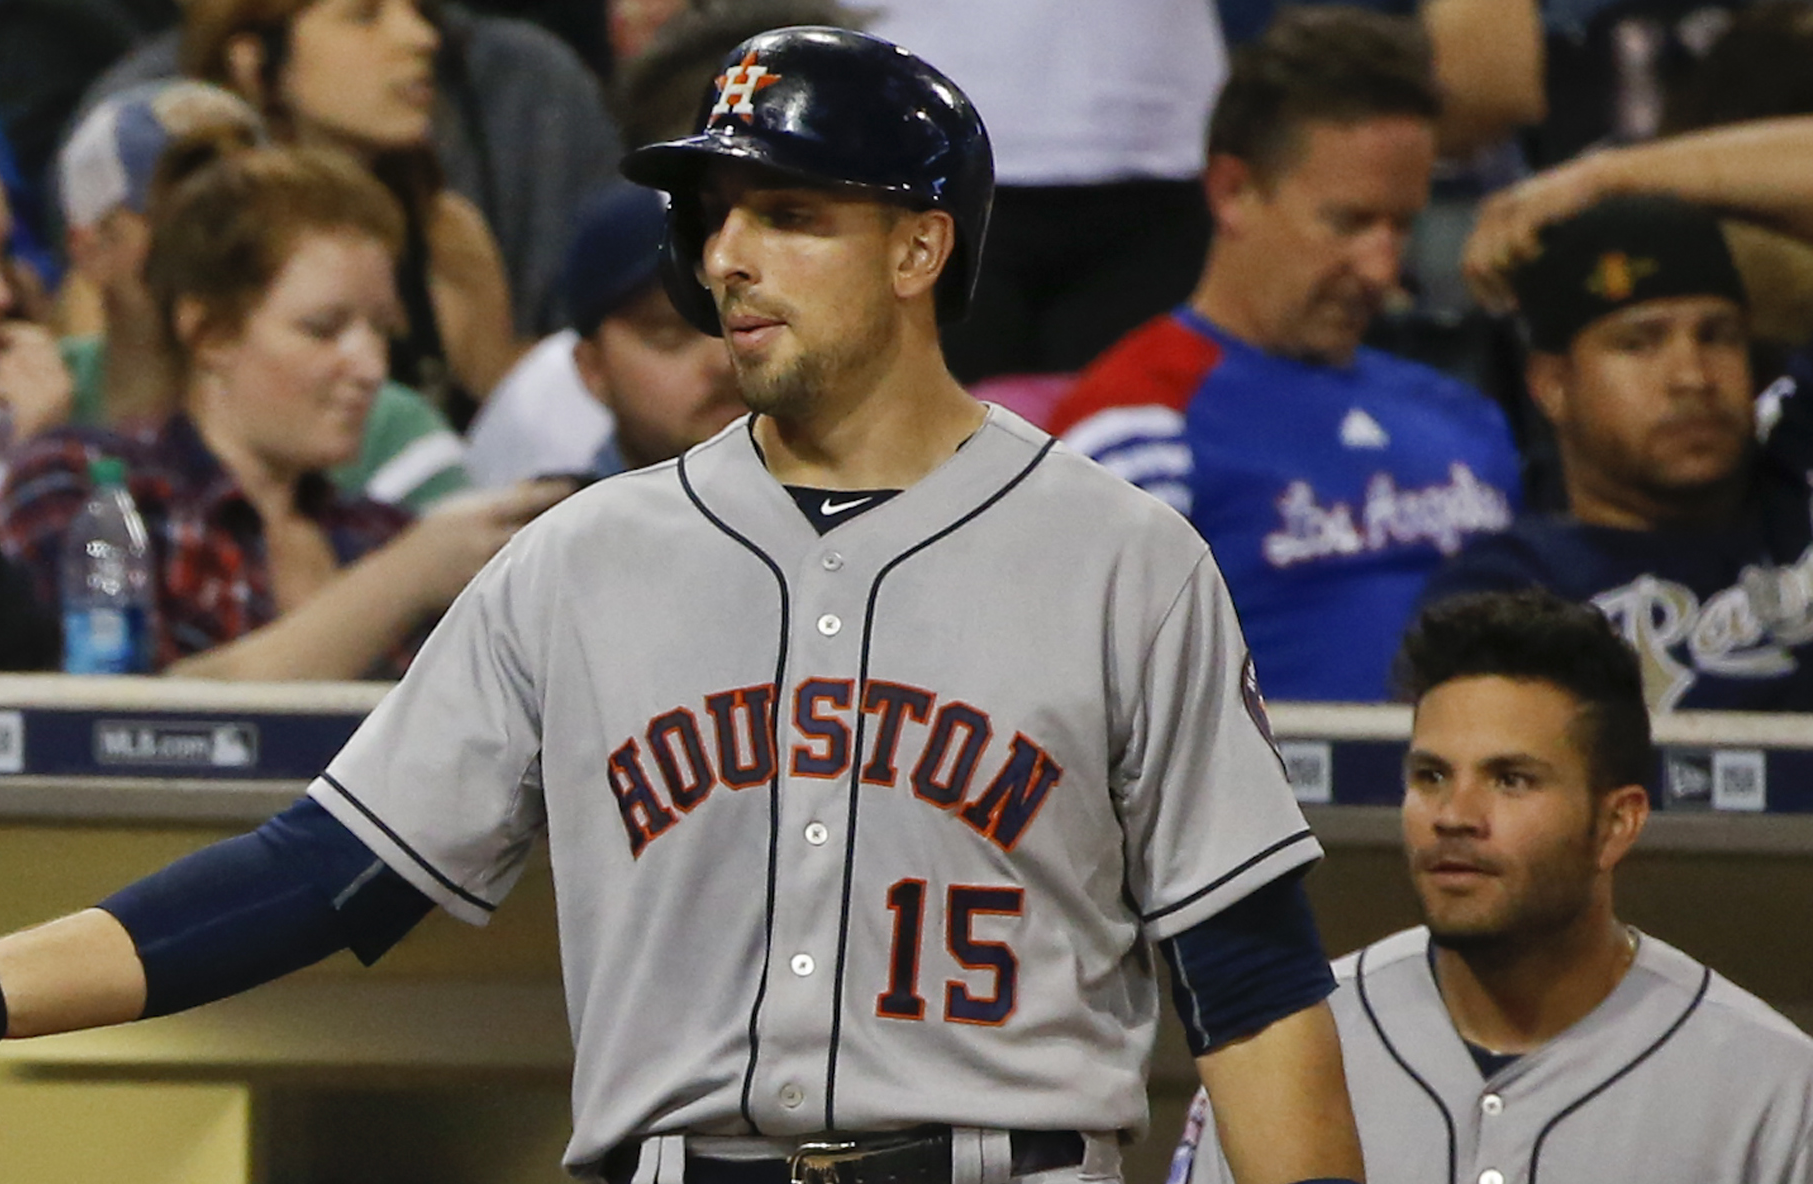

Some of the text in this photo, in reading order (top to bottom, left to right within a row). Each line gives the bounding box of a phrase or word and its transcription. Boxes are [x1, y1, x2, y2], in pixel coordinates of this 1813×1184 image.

[711, 64, 768, 115] H
[606, 676, 1065, 862] HOUSTON
[875, 876, 1025, 1028] 15
